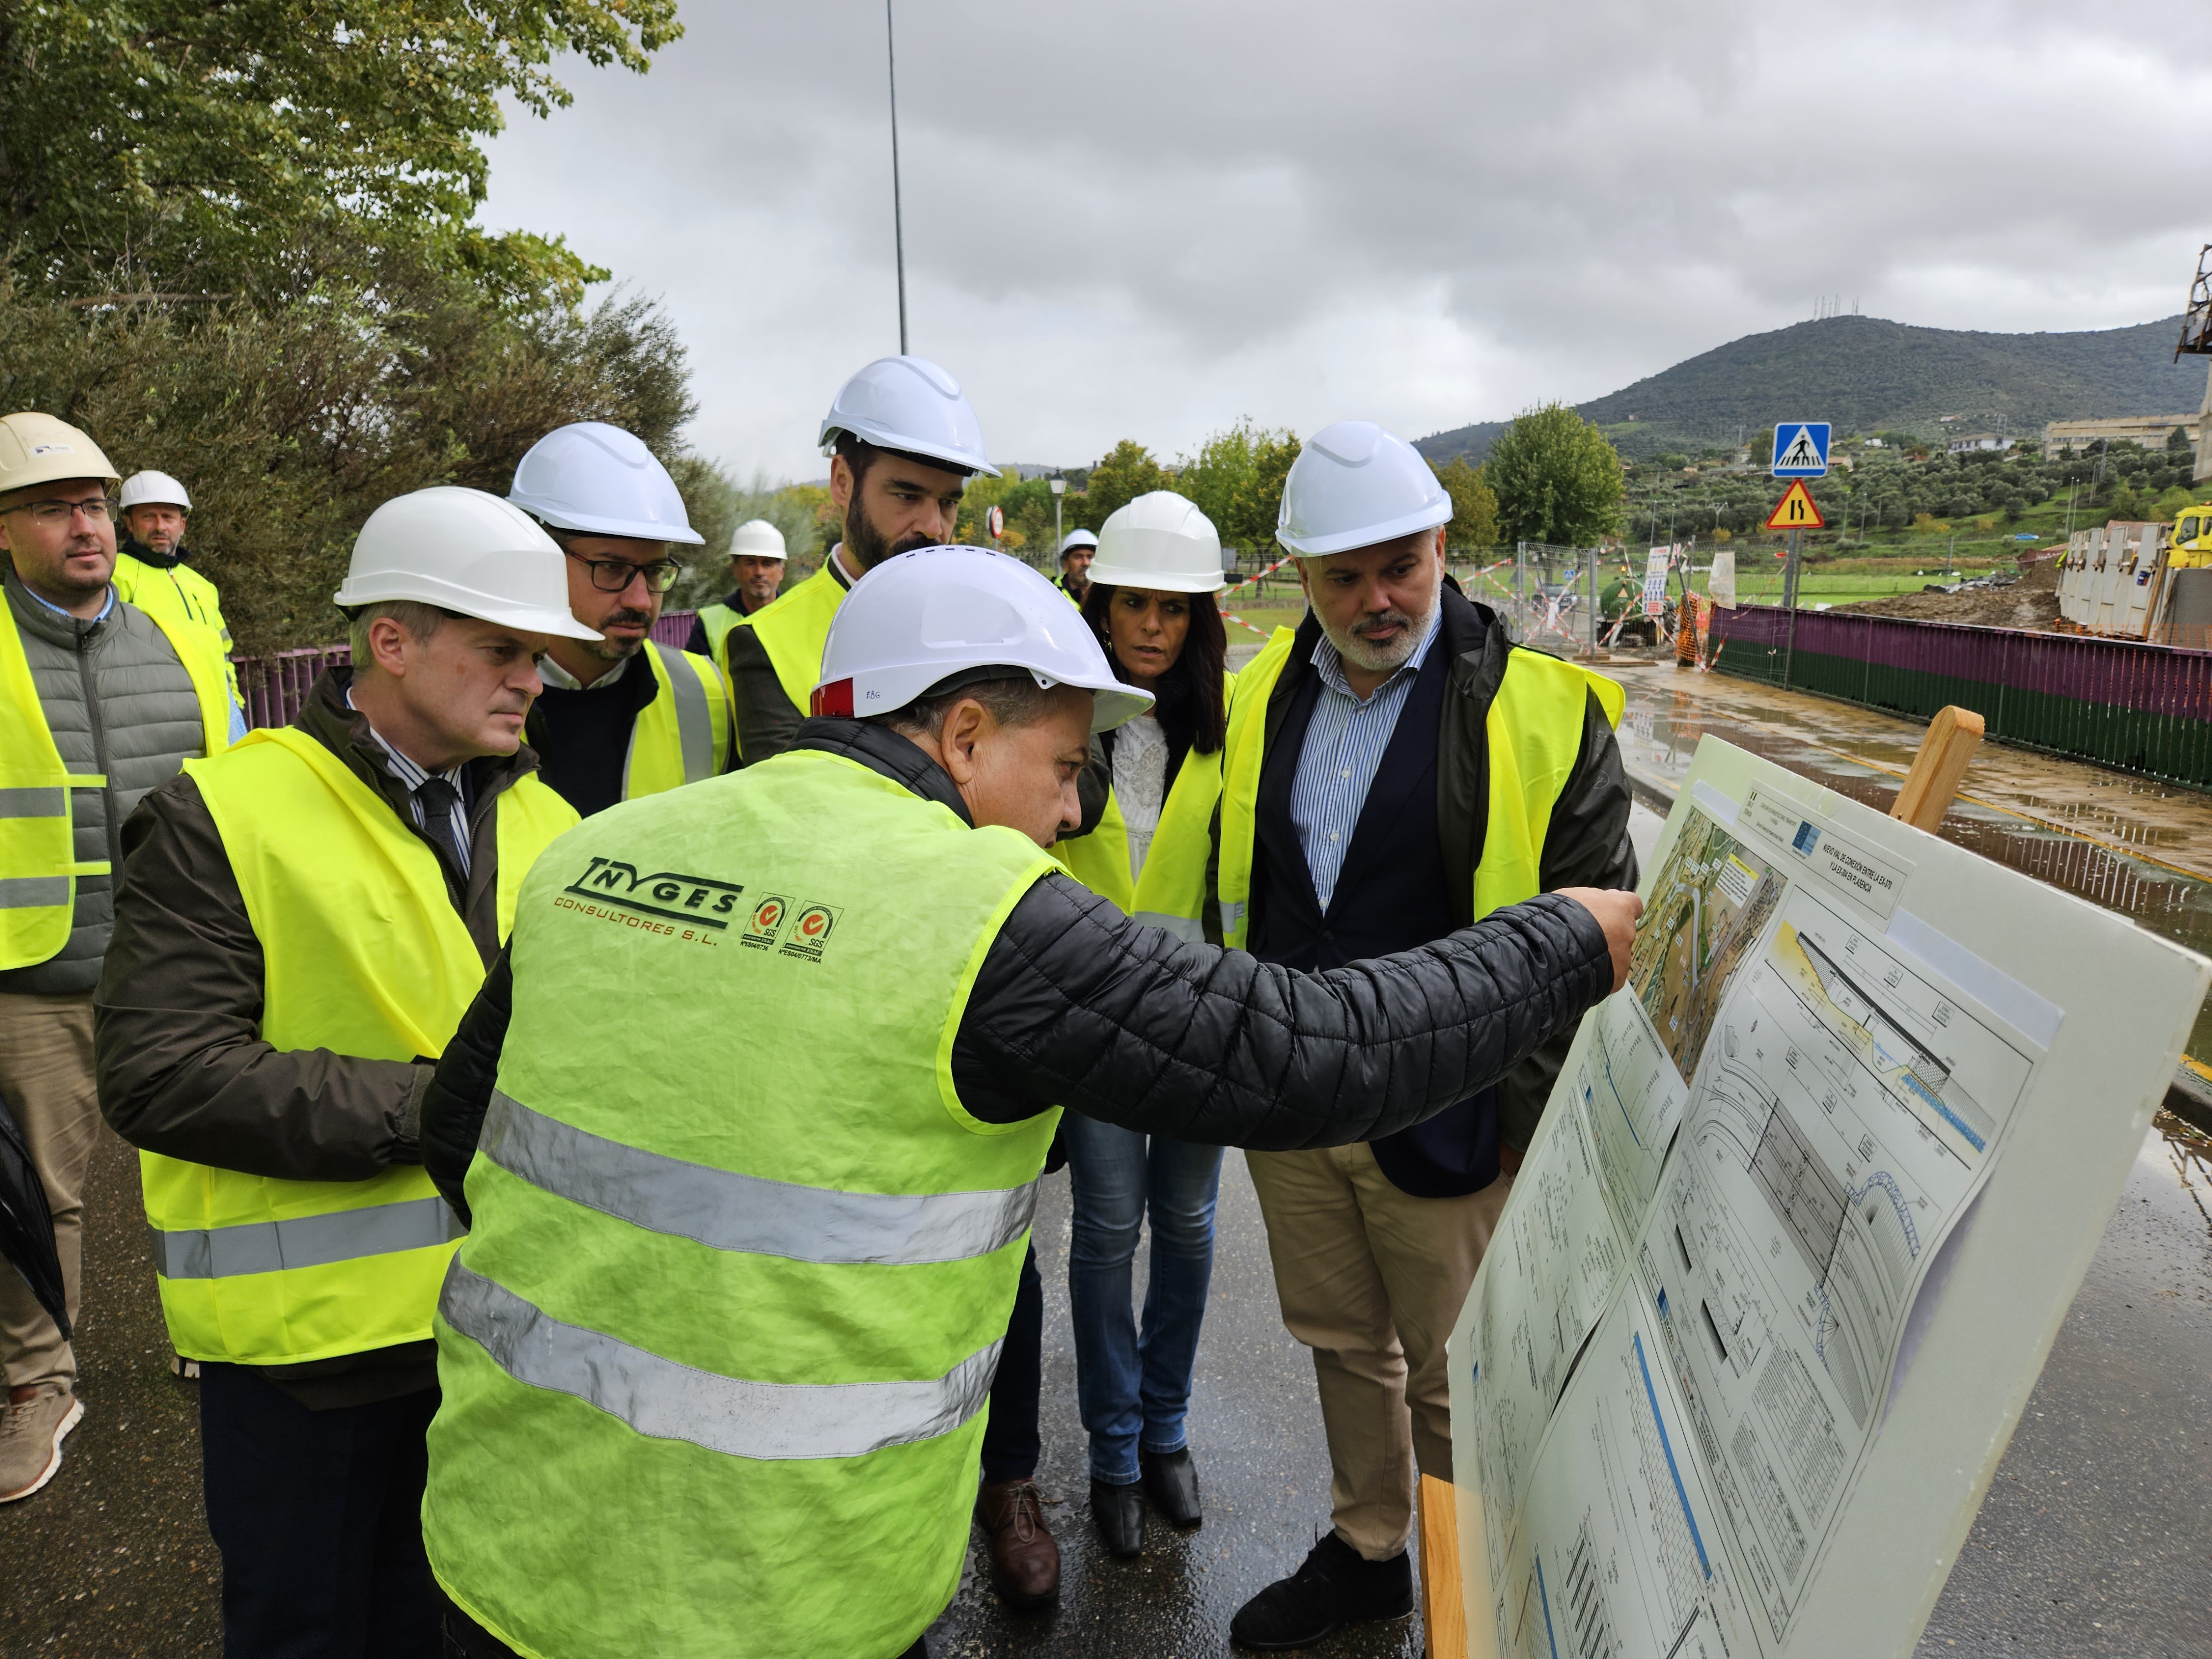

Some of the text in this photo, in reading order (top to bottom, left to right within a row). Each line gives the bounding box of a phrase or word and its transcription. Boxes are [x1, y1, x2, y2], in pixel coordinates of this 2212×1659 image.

[1823, 843, 1834, 855] NUEVO
[1840, 853, 1846, 862] DE
[1862, 866, 1875, 879] ENTRE
[1873, 873, 1880, 882] LA
[1832, 863, 1838, 872] LA
[554, 897, 717, 946] CONSULTORES S.L.
[764, 928, 777, 937] SGS
[809, 938, 825, 948] SGS
